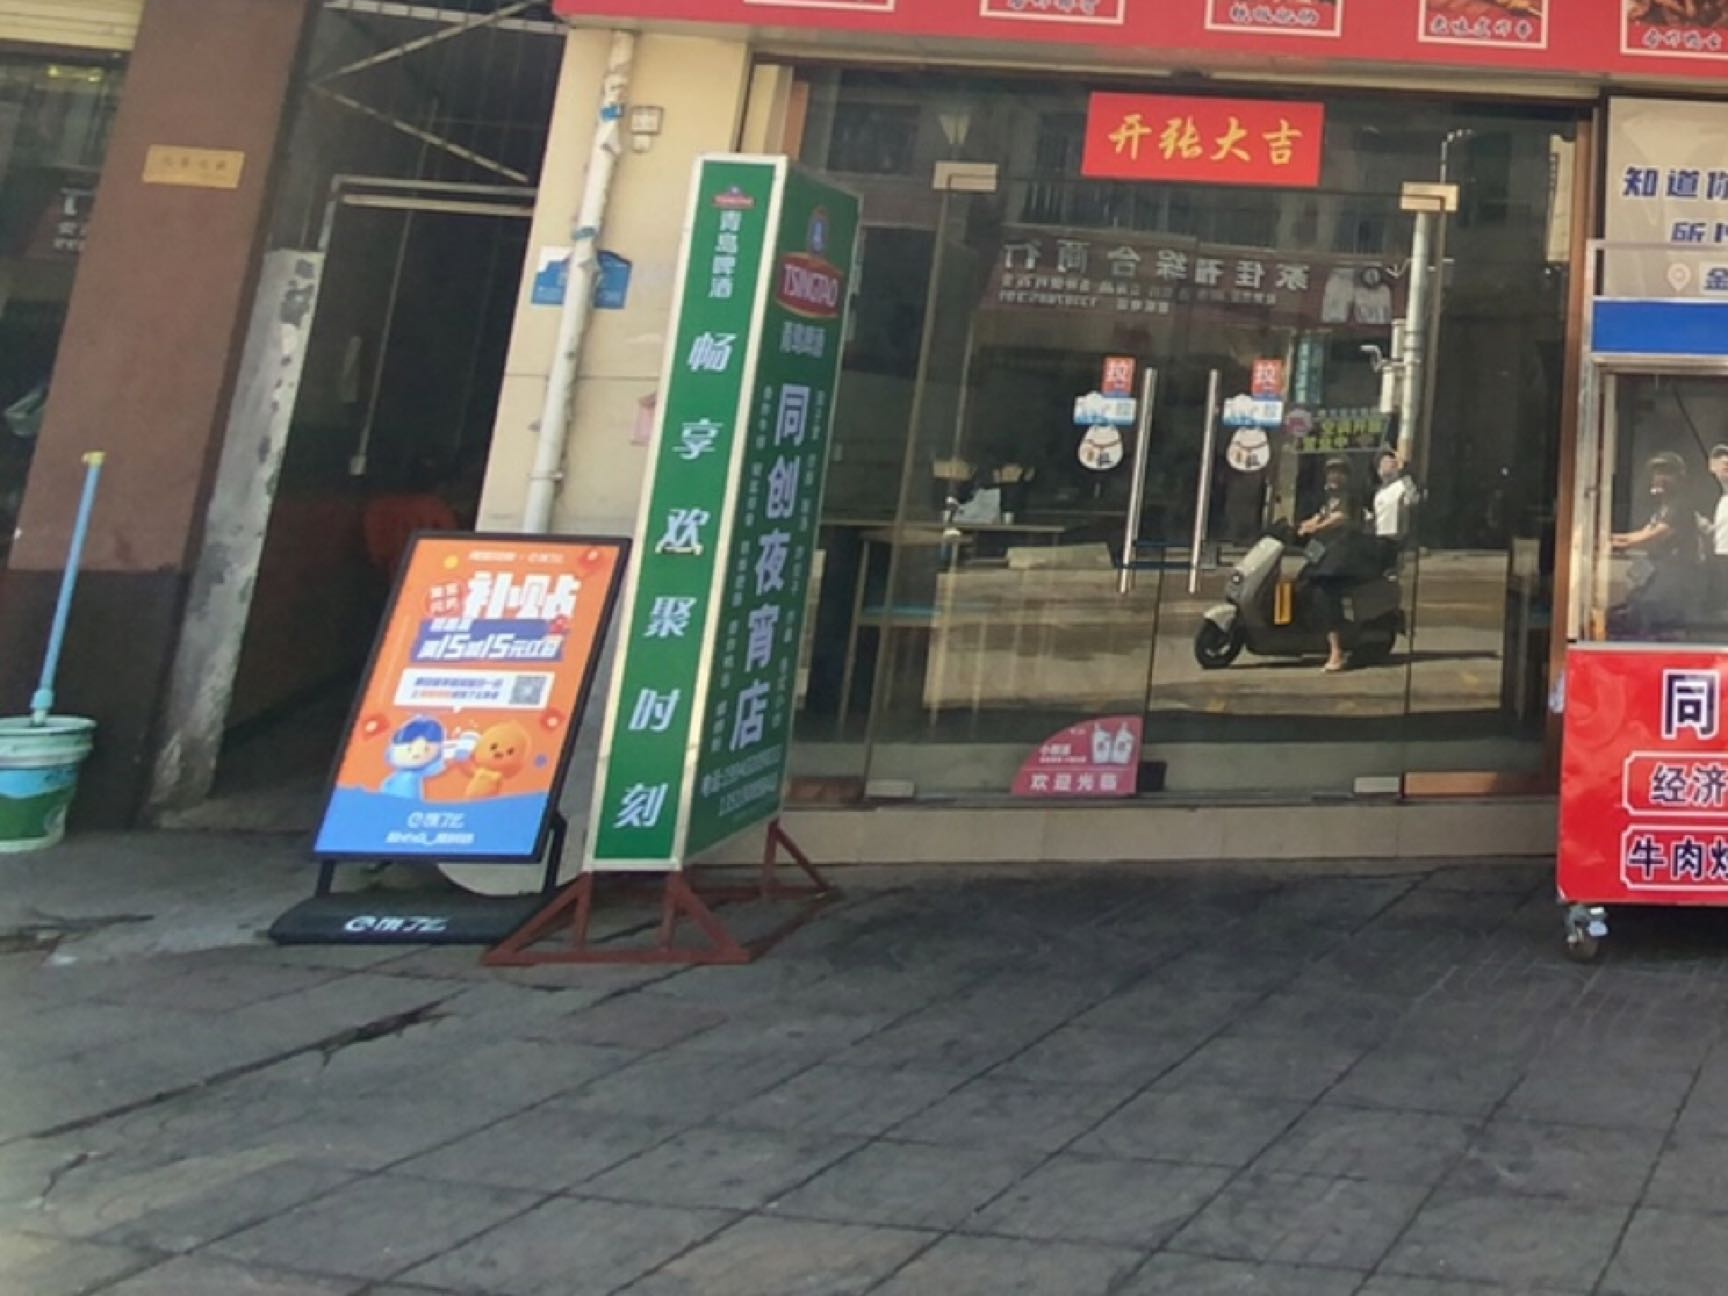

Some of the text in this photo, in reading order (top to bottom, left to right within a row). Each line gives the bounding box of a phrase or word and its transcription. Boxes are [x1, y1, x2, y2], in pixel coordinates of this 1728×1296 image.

[1106, 111, 1304, 167] 开张大吉
[462, 571, 582, 619] 补贴
[612, 331, 737, 829] 畅享欢聚时刻
[729, 382, 811, 752] 同创夜宵店
